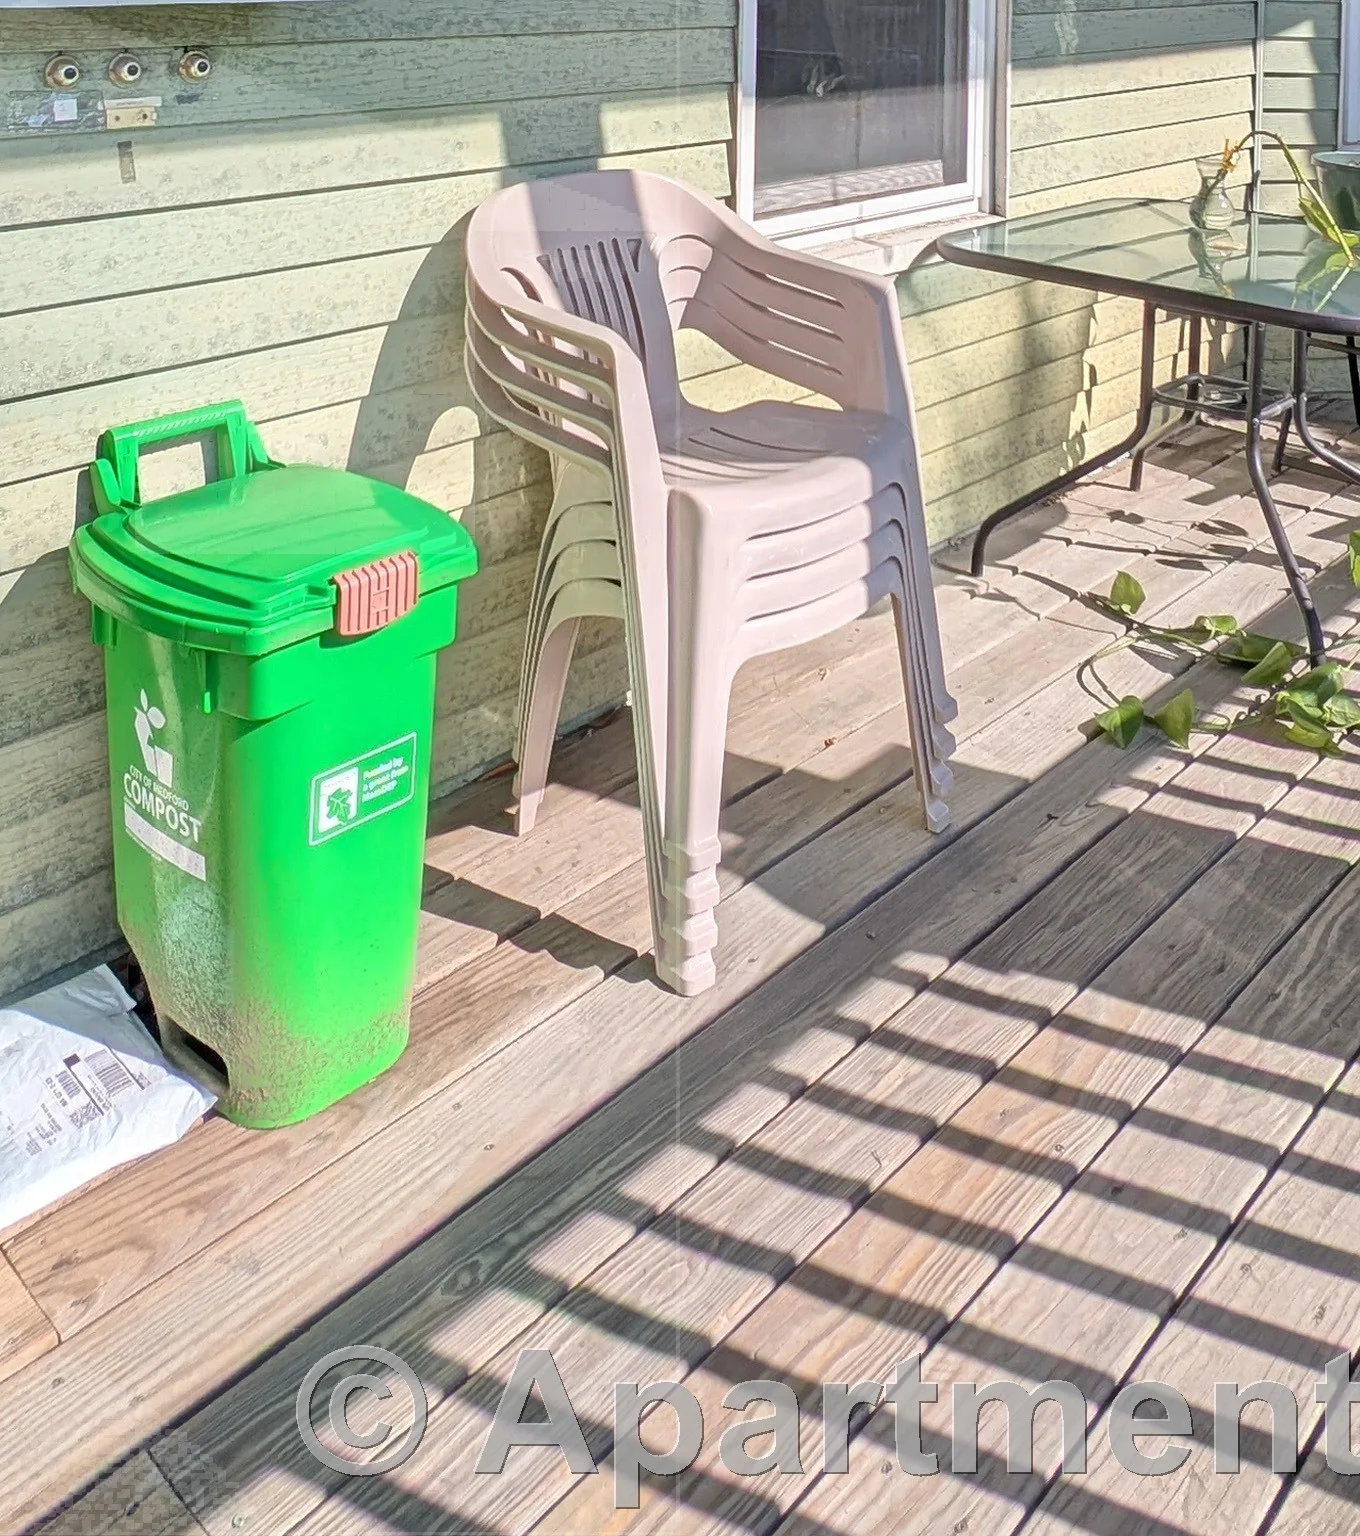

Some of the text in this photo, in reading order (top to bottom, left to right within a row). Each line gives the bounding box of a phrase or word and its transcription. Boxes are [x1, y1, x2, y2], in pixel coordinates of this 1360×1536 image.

[123, 772, 202, 843] COMPOST
[129, 765, 143, 782] CITY
[153, 781, 189, 811] MEDFORD
